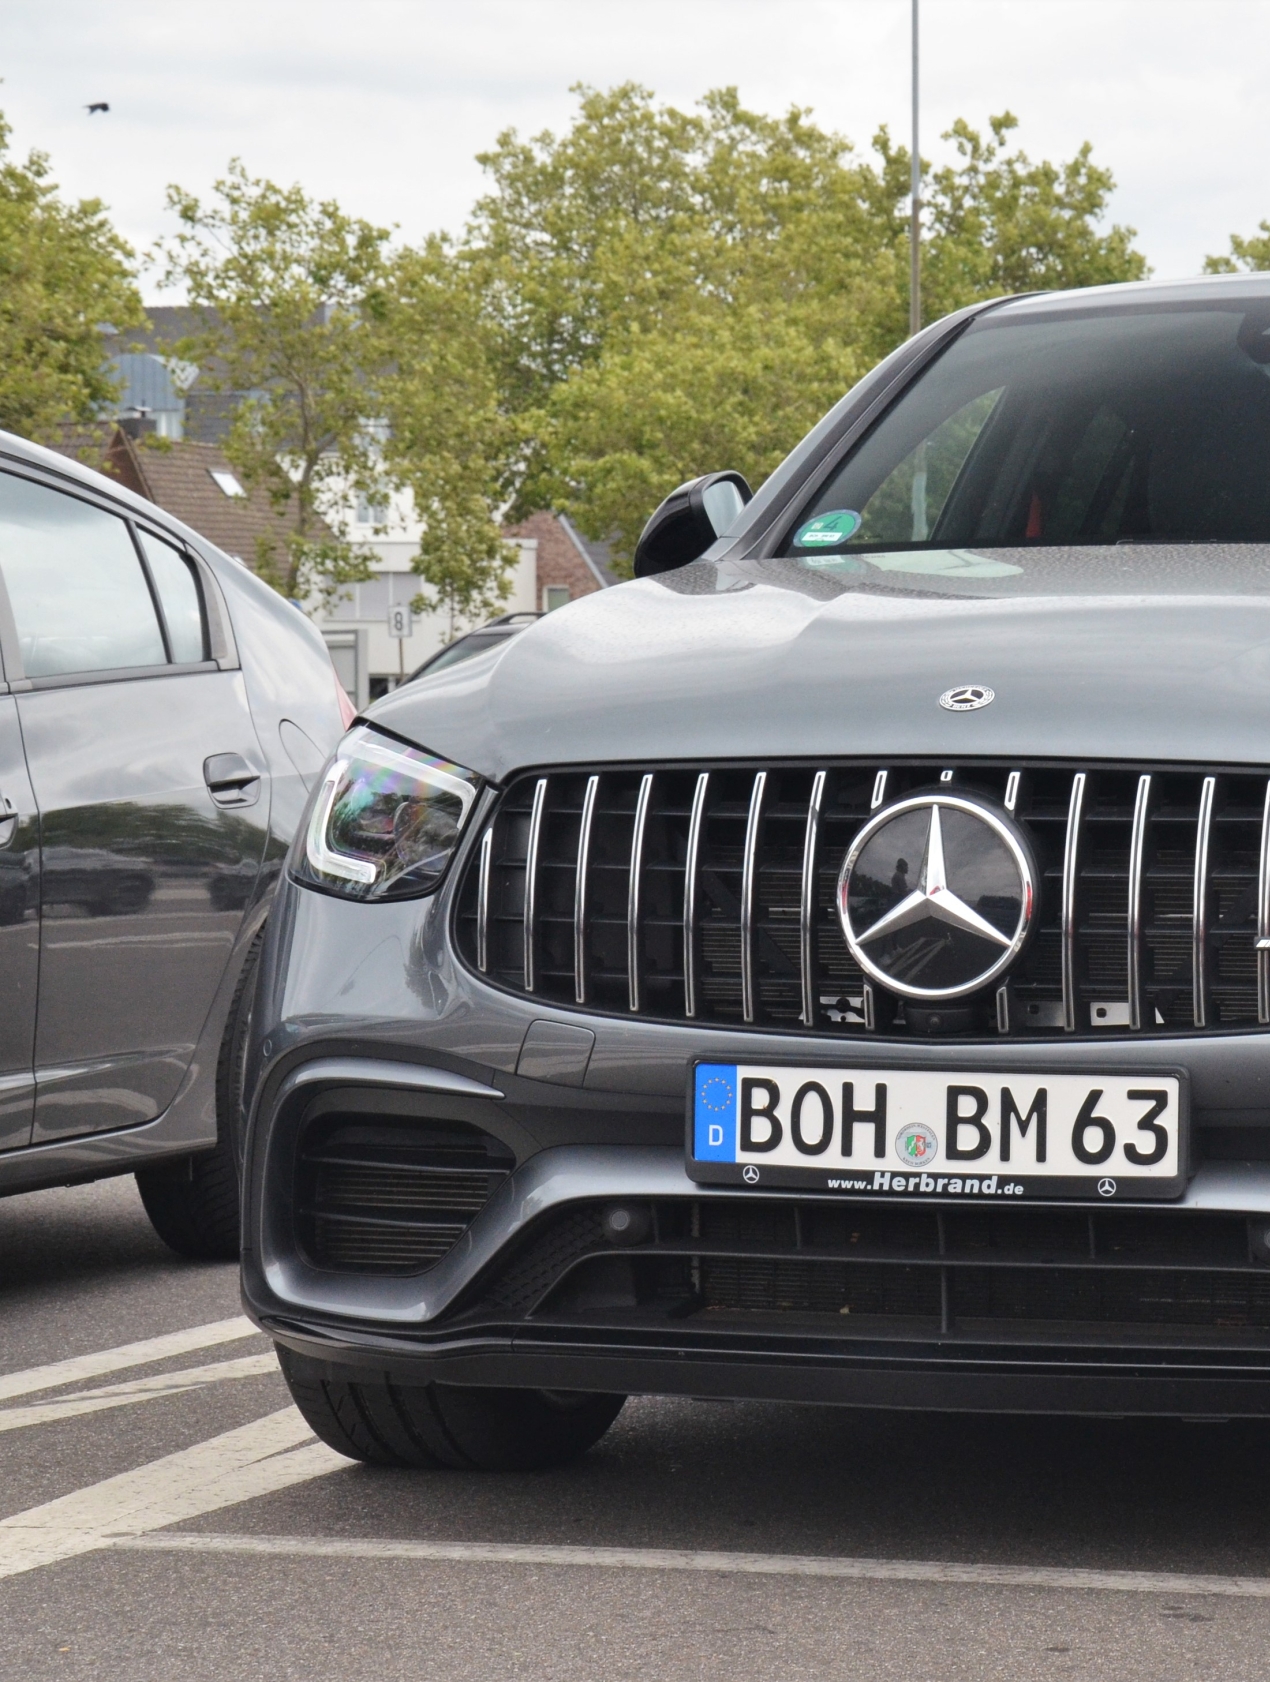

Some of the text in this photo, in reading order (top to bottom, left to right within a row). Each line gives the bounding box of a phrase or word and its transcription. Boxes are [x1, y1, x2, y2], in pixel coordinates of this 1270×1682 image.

[823, 515, 843, 531] 4
[394, 611, 403, 631] 8
[740, 1077, 1169, 1166] BOH BM 63
[708, 1124, 724, 1146] D
[827, 1171, 1025, 1195] www.Herbrand.de
